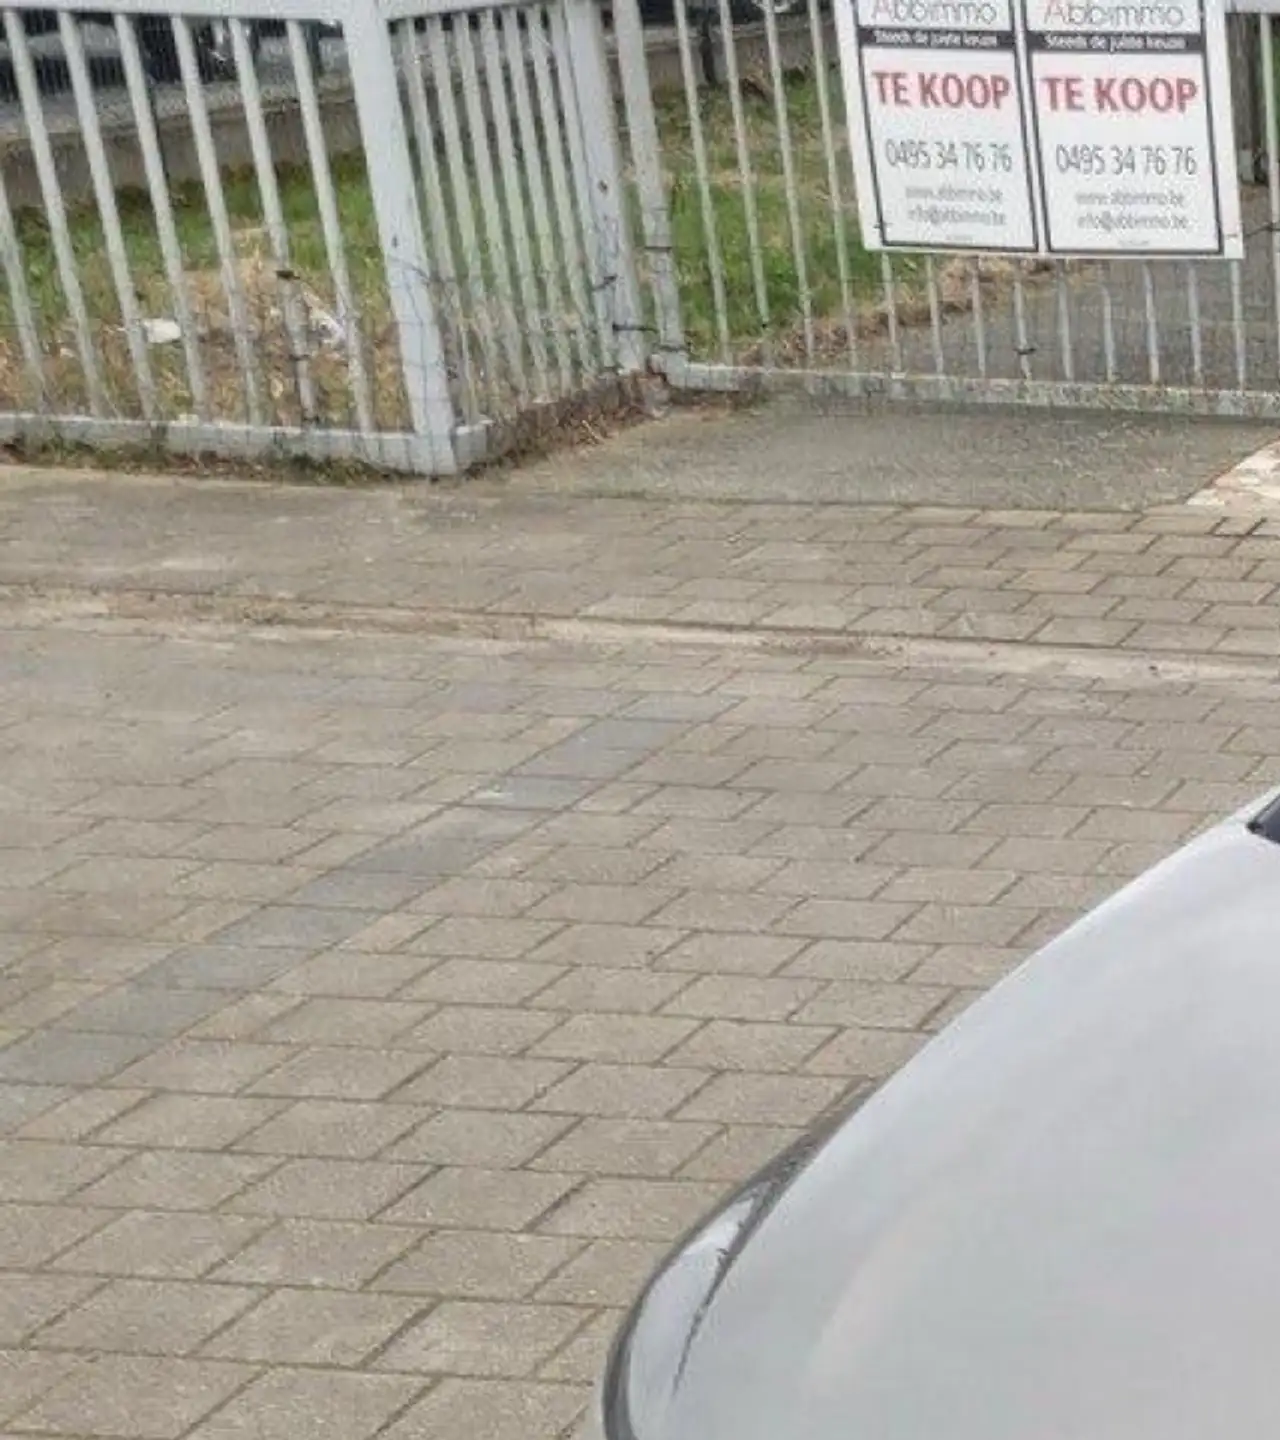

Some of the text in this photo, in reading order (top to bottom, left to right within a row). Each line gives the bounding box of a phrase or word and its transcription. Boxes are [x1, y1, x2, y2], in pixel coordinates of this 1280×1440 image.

[1089, 35, 1107, 49] de
[872, 71, 1010, 109] TE KOOP
[1041, 77, 1198, 112] TE KOOP
[885, 138, 1012, 172] 0495 34 76 76
[1055, 143, 1197, 175] 0495 34 76 76
